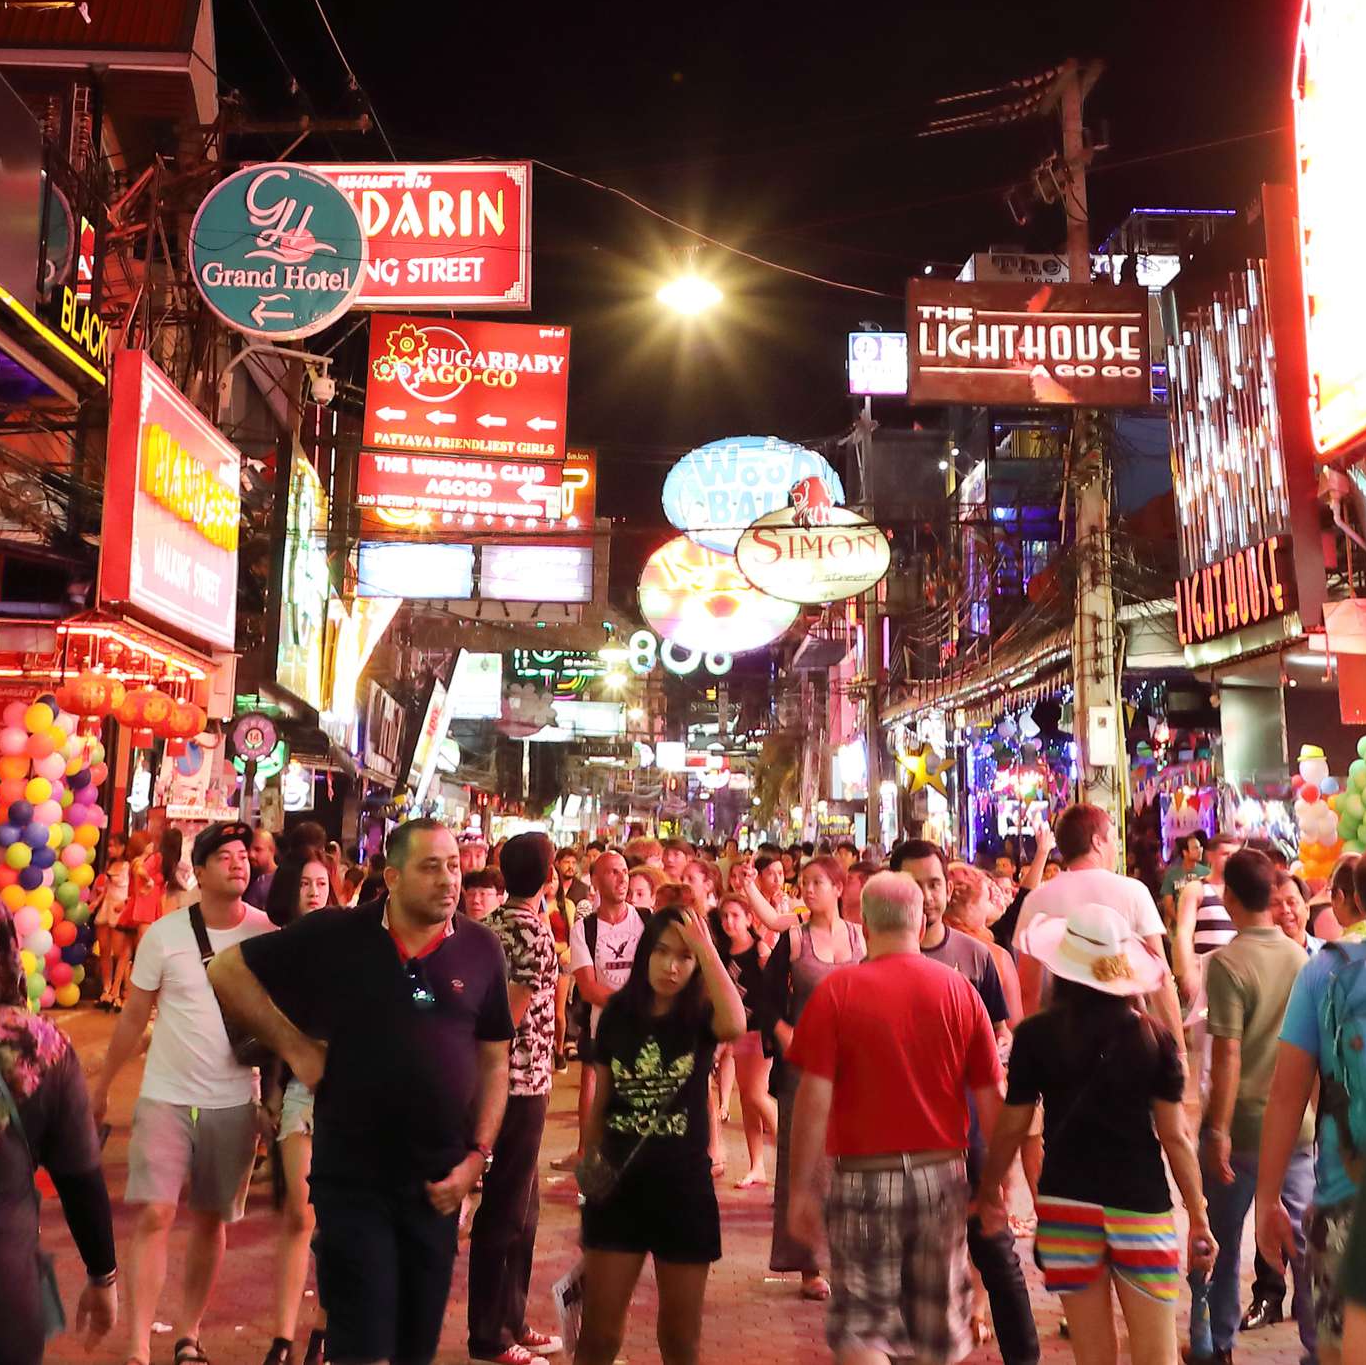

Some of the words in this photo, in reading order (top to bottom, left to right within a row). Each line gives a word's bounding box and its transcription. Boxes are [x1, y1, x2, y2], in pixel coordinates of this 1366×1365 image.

[349, 188, 506, 239] DARIN
[201, 261, 277, 289] Grand
[284, 264, 352, 293] Hotel
[407, 256, 485, 284] STREET
[60, 284, 110, 368] BLACK
[917, 304, 974, 321] THE
[918, 321, 1141, 361] LIGHTHOUSE
[427, 348, 565, 374] SUGARBABY
[1054, 364, 1096, 378] GO
[1101, 365, 1142, 378] GO
[420, 366, 519, 388] AGO-GO
[373, 433, 433, 448] PATTAYA
[433, 435, 516, 453] FRIENDLIEST
[516, 442, 556, 456] GIRLS
[374, 456, 409, 474] THE
[500, 466, 546, 483] CLUB
[425, 478, 494, 499] AGOGO
[753, 526, 879, 565] SIMON
[1175, 536, 1284, 645] LIGHTHOUSE
